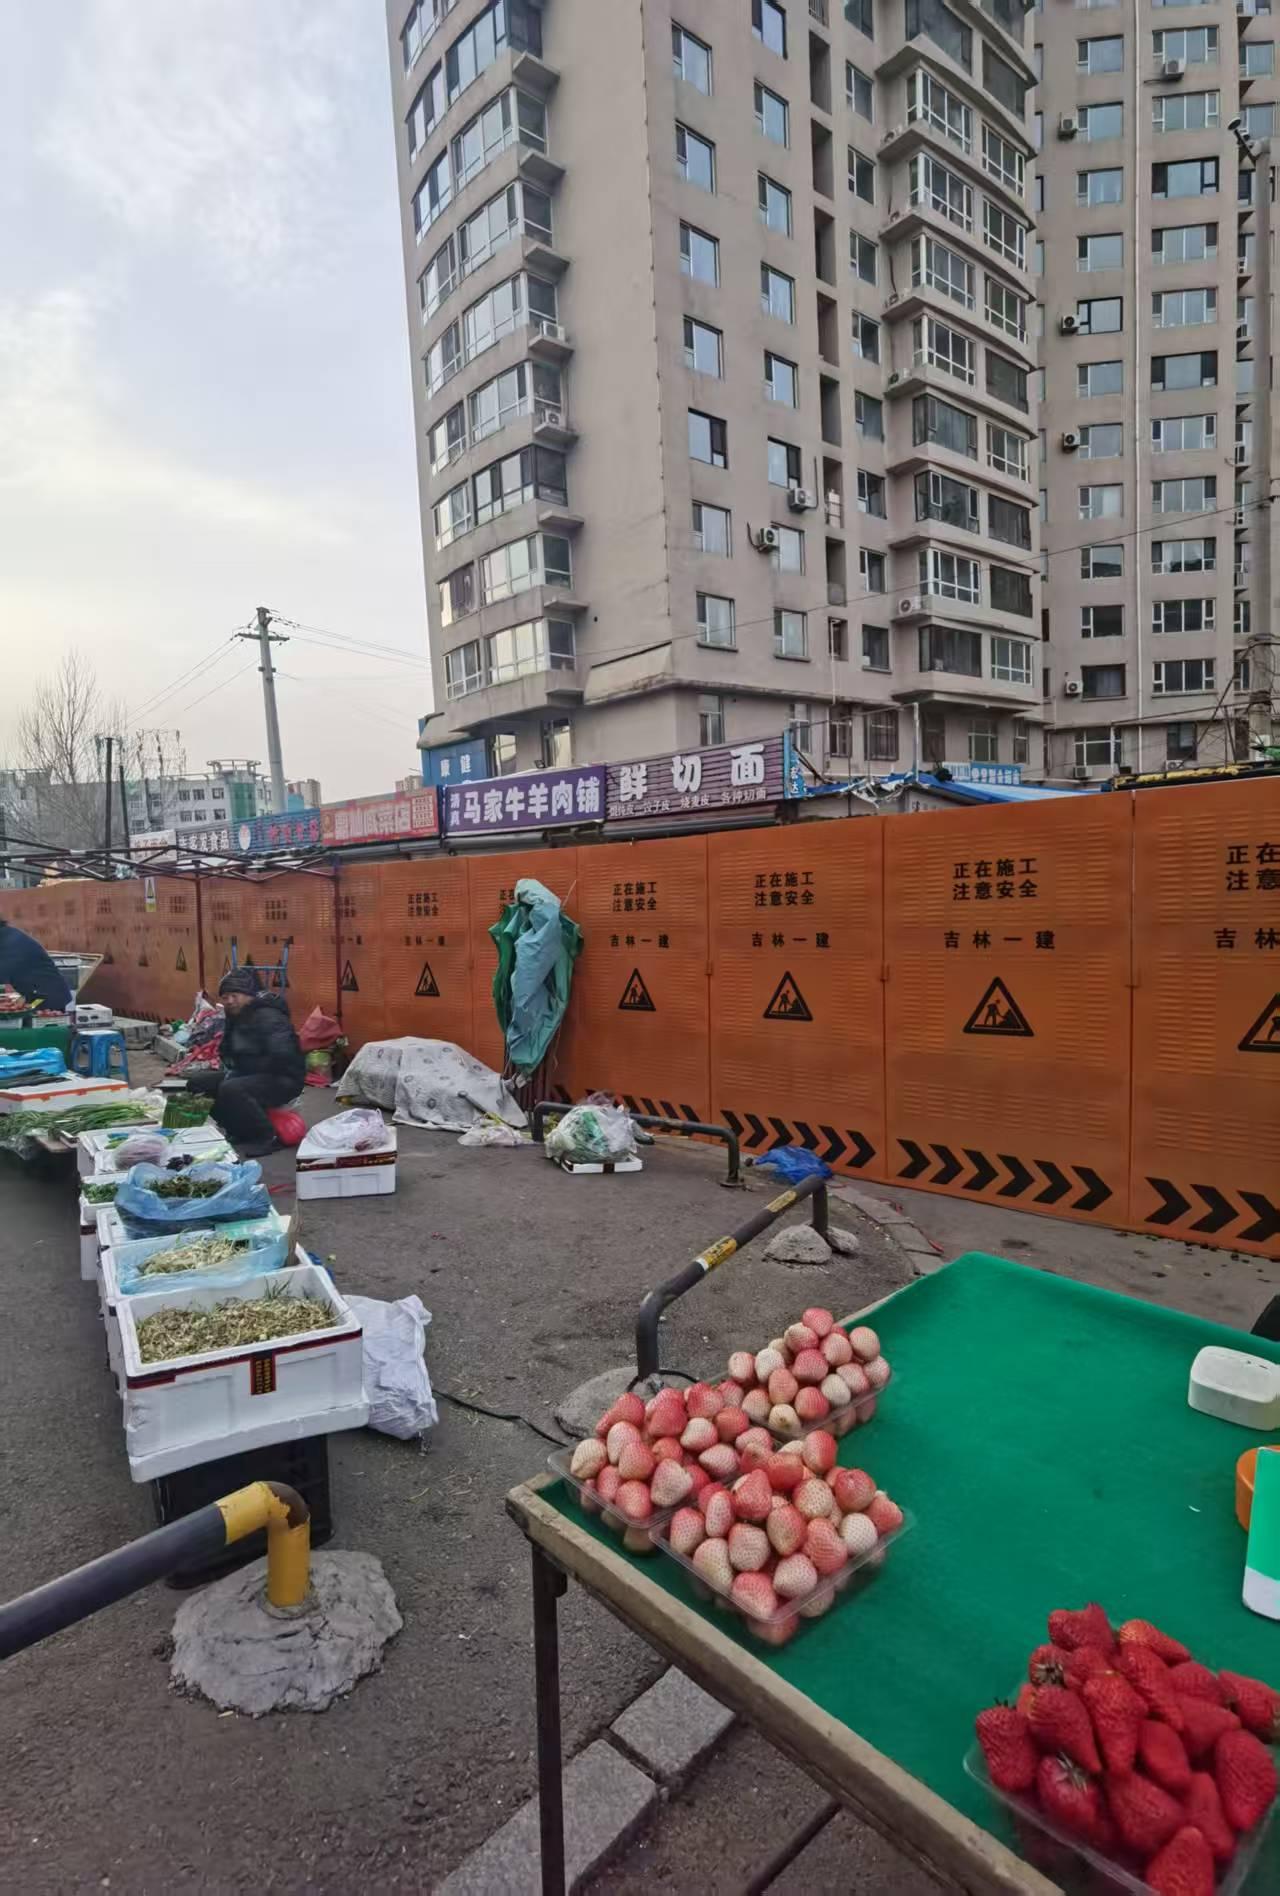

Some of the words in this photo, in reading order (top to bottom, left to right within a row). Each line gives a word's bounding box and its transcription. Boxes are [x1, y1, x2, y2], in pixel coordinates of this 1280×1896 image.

[619, 743, 765, 802] 鲜切面
[463, 776, 600, 824] 马家牛羊肉铺
[953, 857, 1039, 879] 正在施工
[613, 881, 657, 896] 正在施工
[754, 871, 815, 888] 正在施工
[754, 889, 815, 907] 注意安全
[952, 879, 1039, 901] 注意安全
[612, 897, 657, 912] 注意安全
[609, 931, 670, 949] 吉林一建
[751, 931, 831, 949] 吉林一建
[944, 929, 1056, 950] 吉林一建
